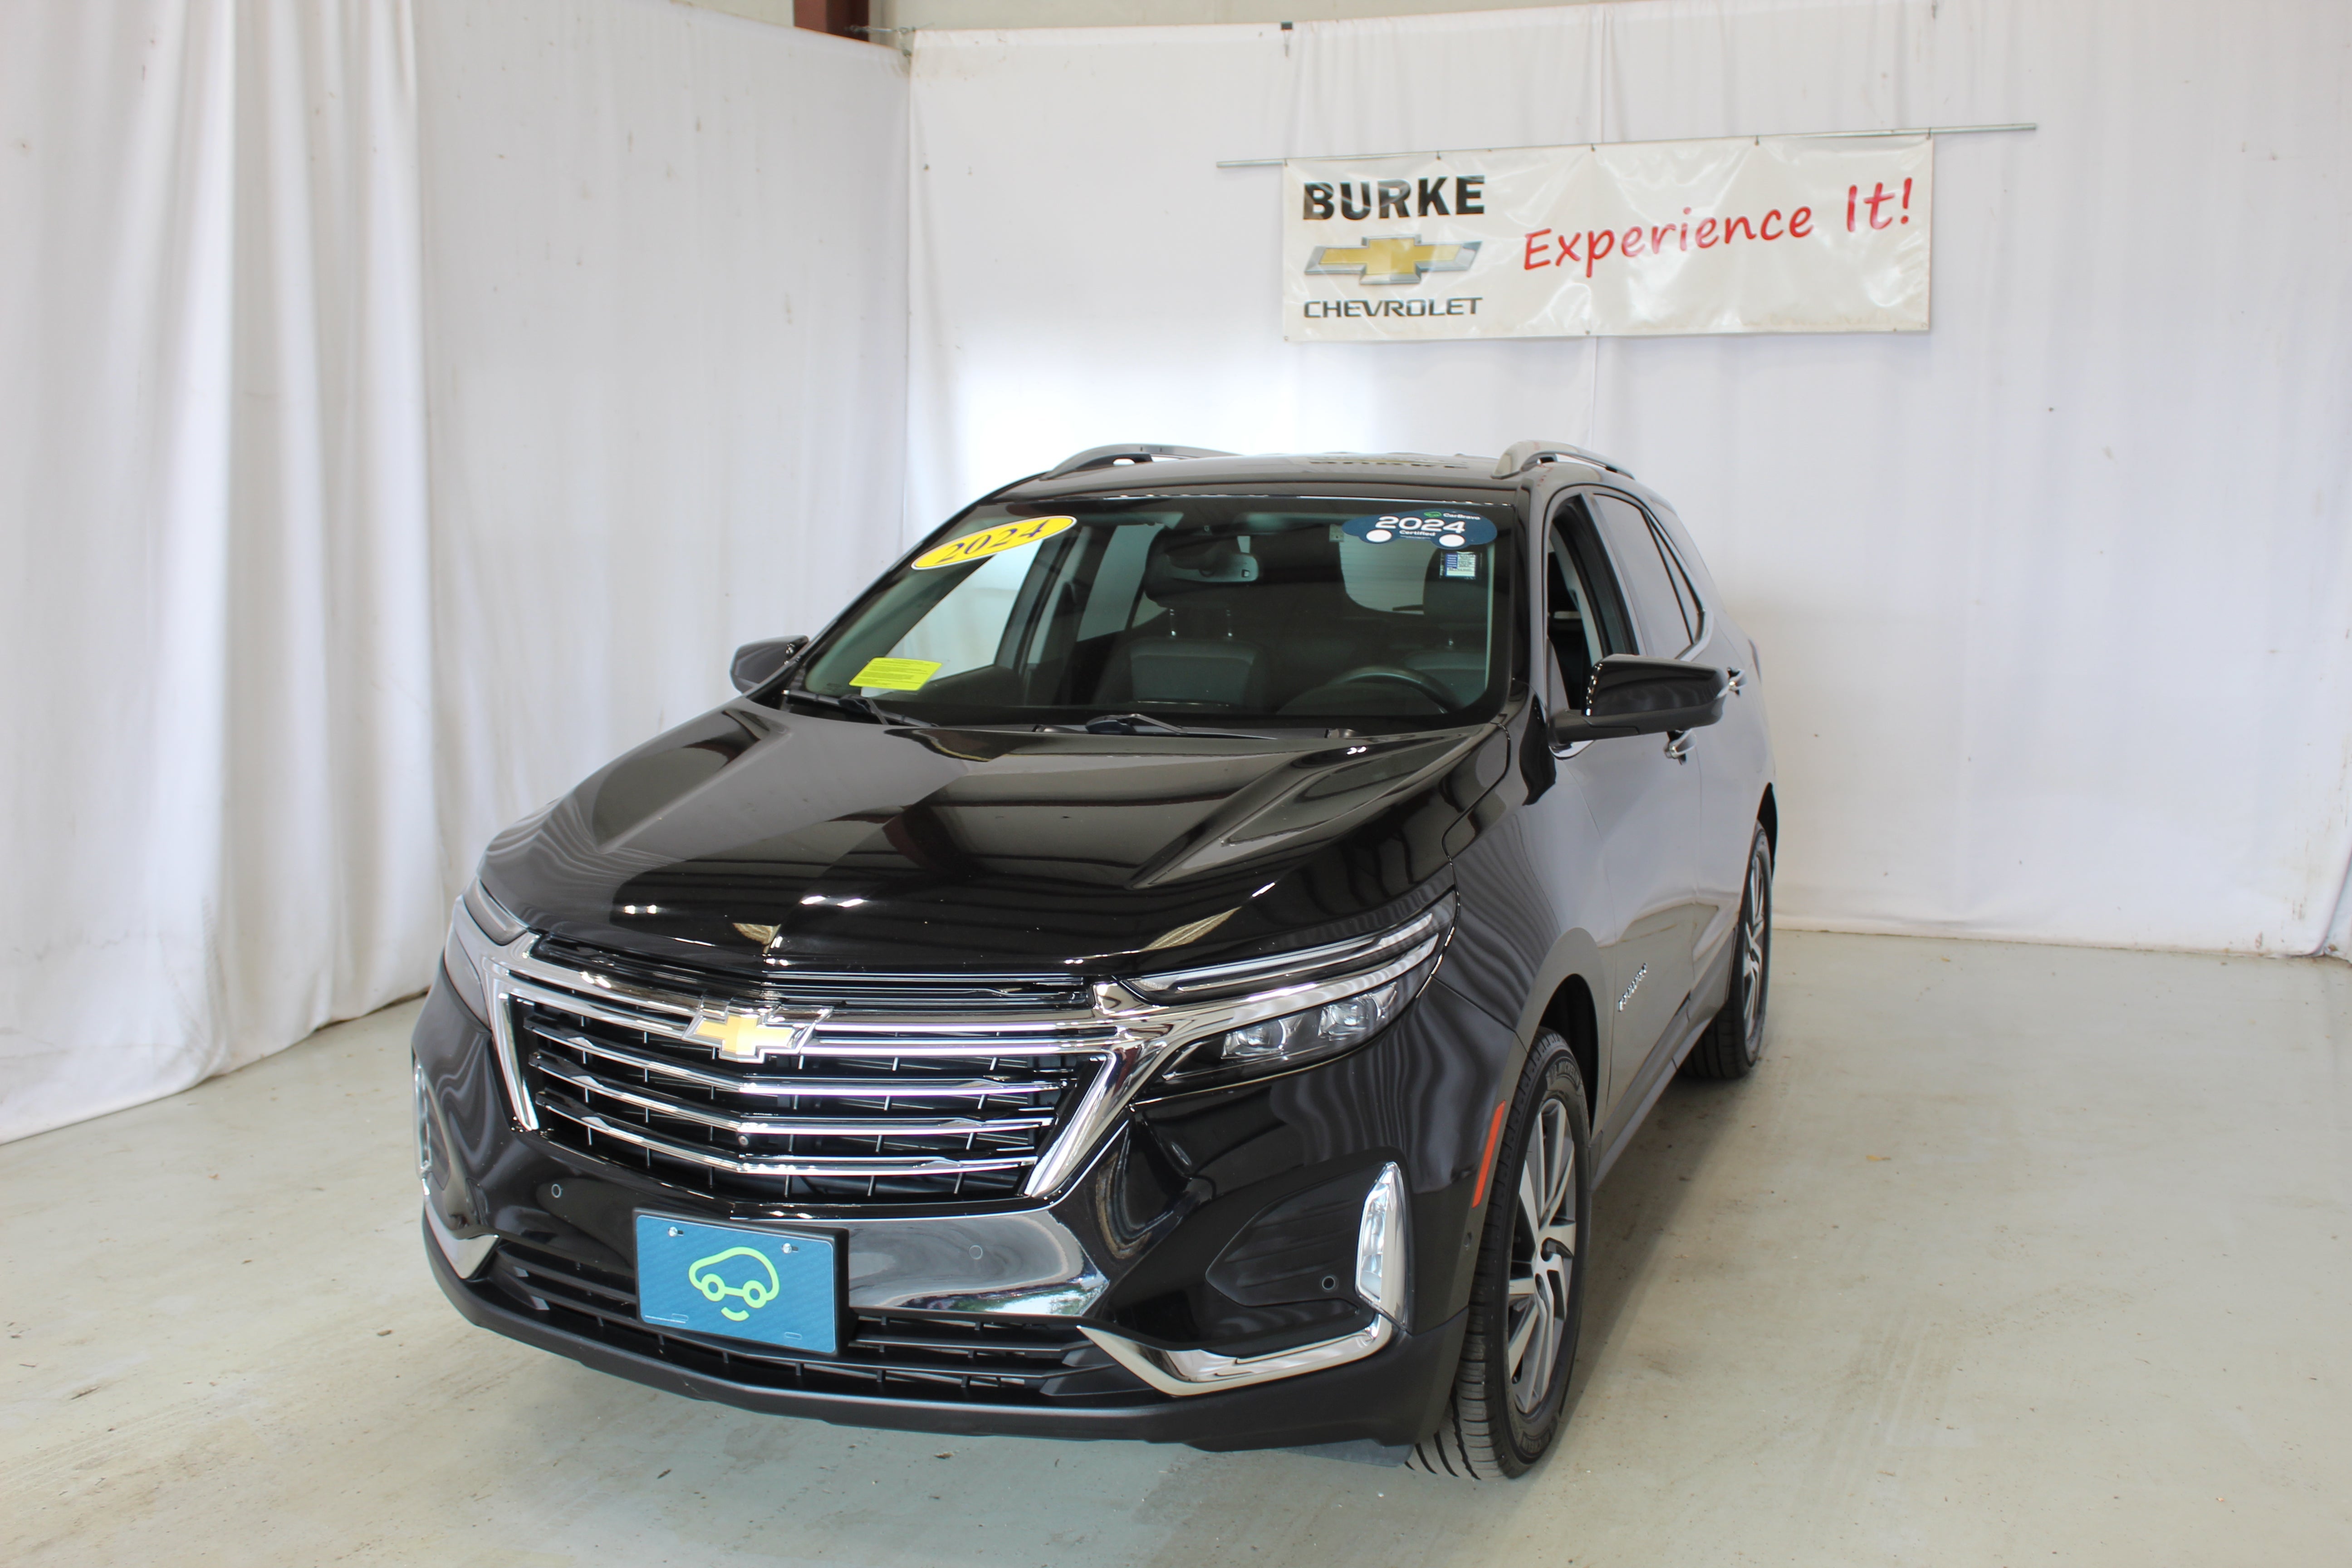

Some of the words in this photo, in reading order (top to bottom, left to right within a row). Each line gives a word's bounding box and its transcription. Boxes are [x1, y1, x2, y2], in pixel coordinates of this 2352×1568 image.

[1303, 175, 1485, 220] BURKE
[1524, 206, 1814, 278] Experience
[1846, 177, 1913, 232] It!
[1303, 297, 1483, 318] CHEVROLET
[935, 519, 1051, 564] 2024
[1375, 515, 1466, 534] 2024
